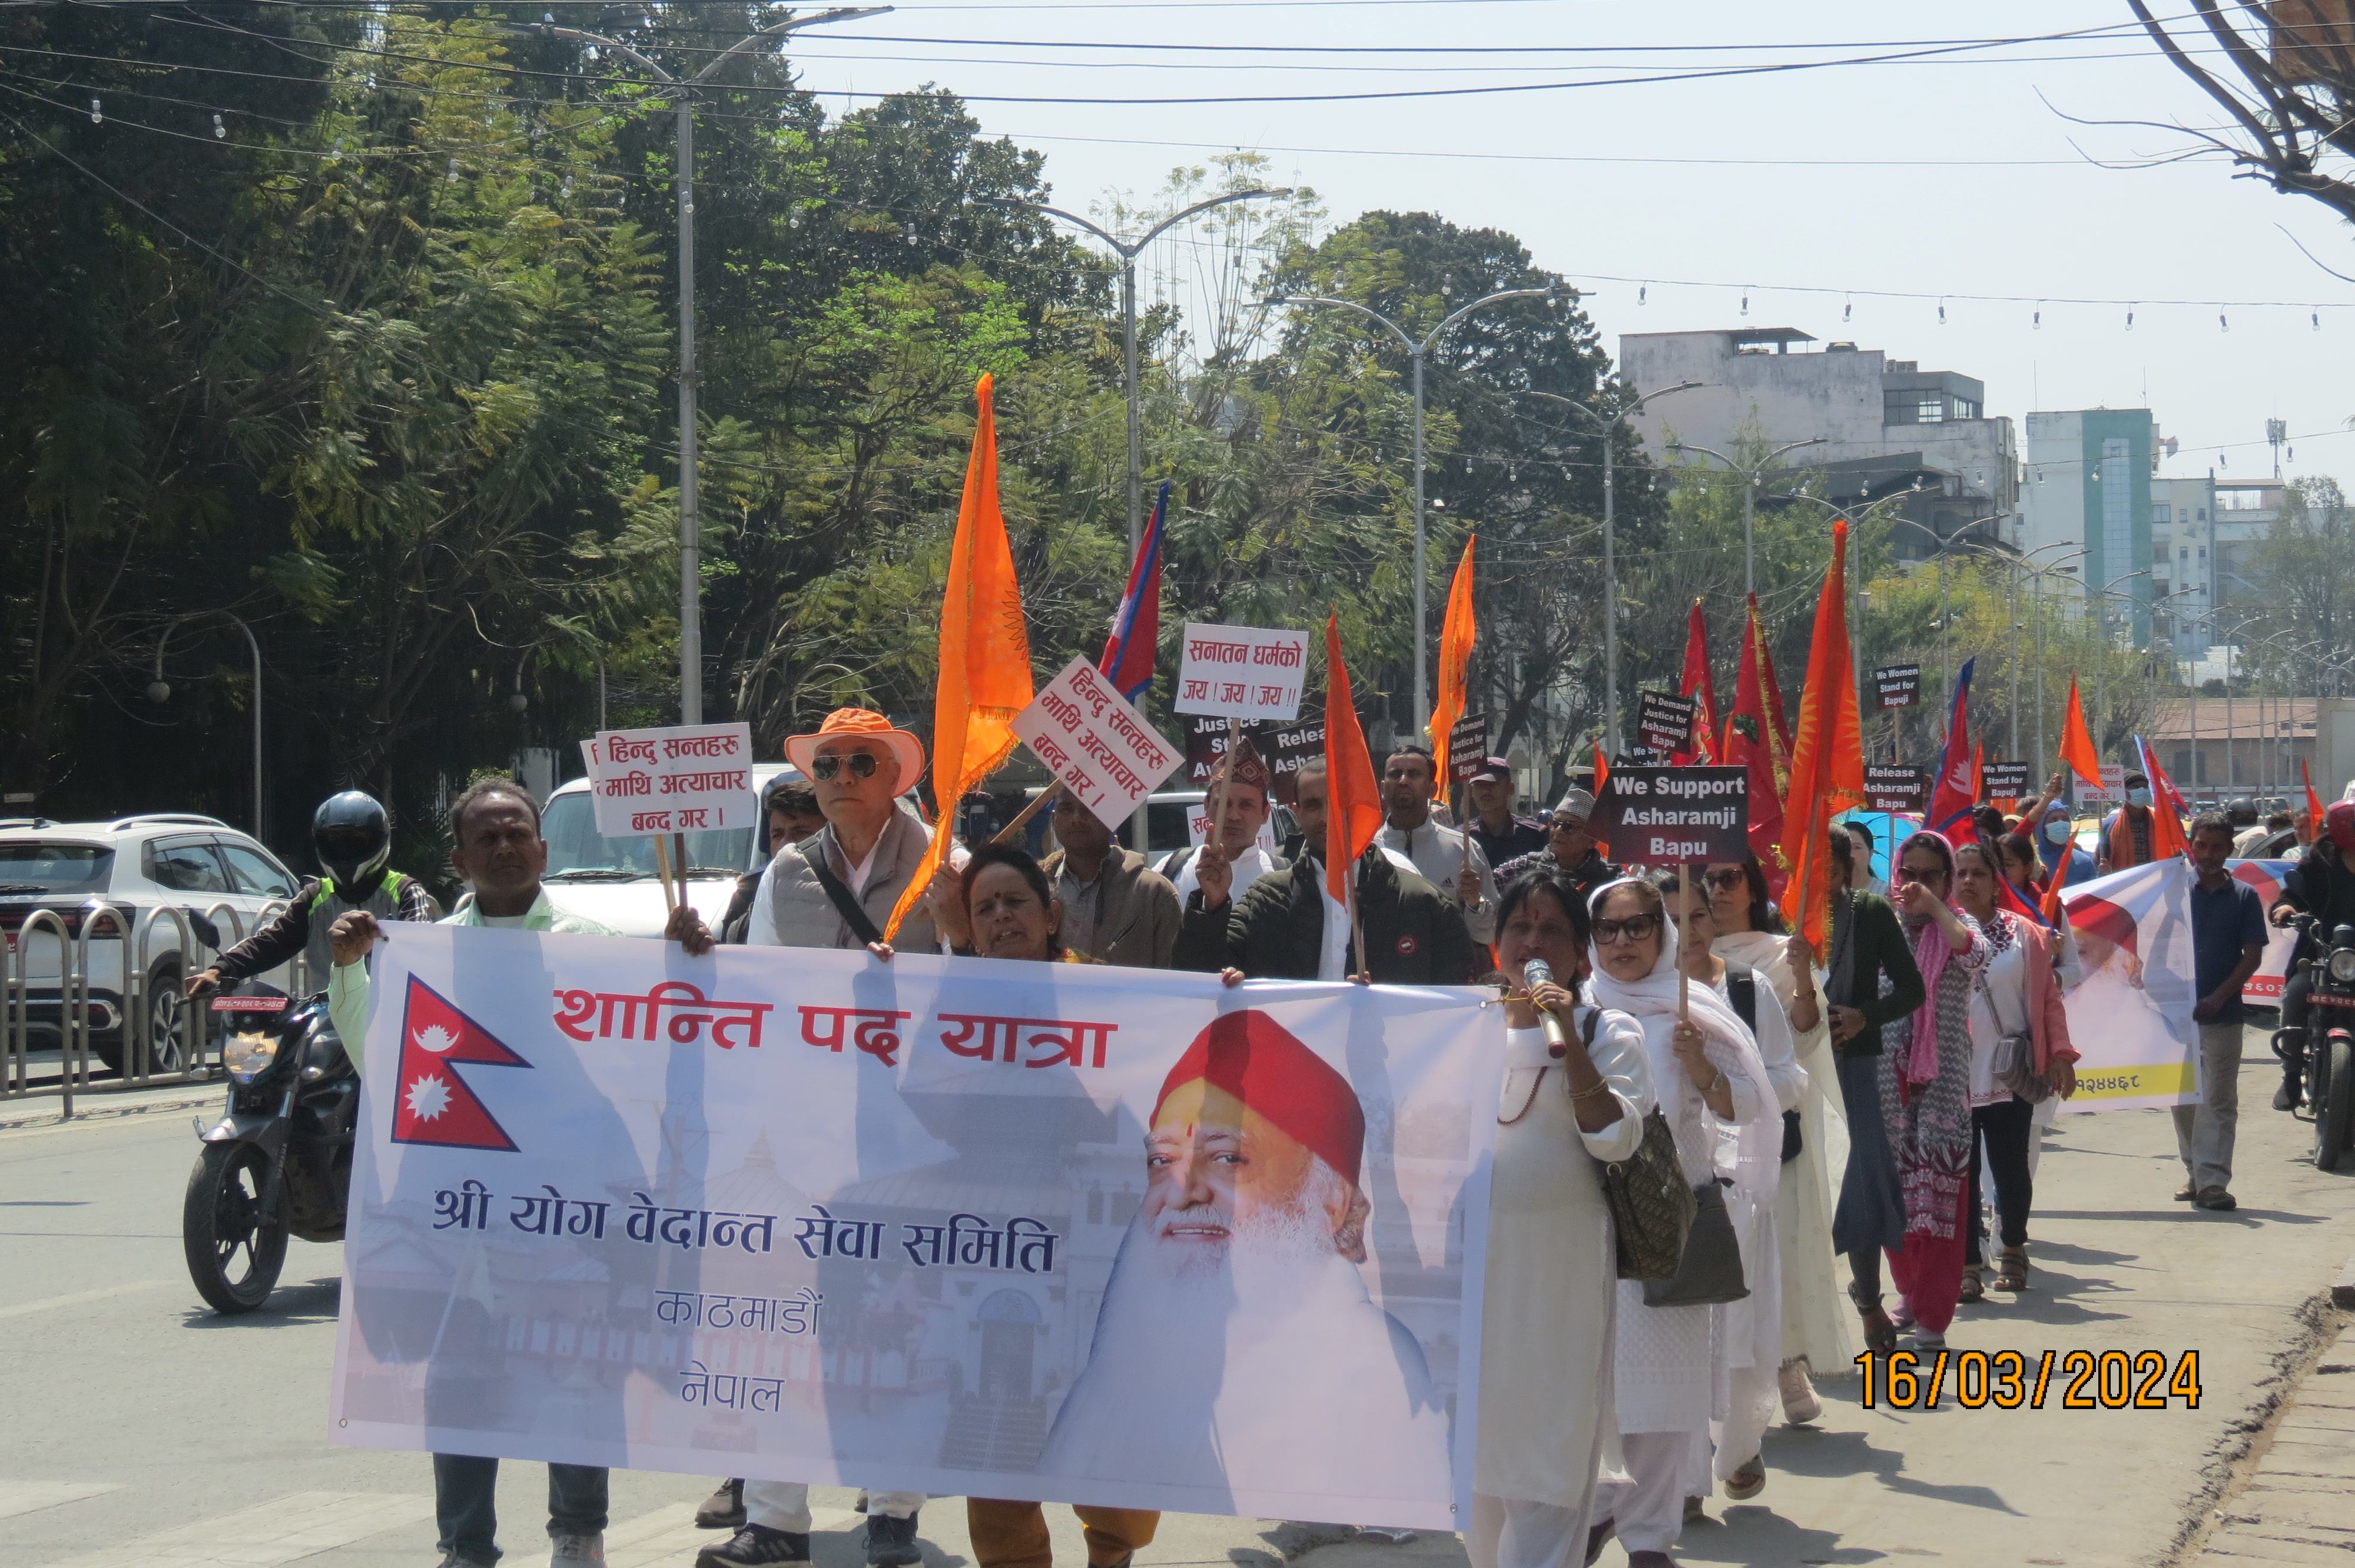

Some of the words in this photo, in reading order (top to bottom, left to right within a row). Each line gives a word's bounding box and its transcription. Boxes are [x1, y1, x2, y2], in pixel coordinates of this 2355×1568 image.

[1189, 640, 1250, 664] सनातन
[1253, 640, 1302, 668] धर्मको
[1876, 672, 1886, 680] We
[1888, 669, 1918, 678] Women
[1183, 680, 1209, 700] जय
[1220, 683, 1246, 704] जय
[1258, 686, 1283, 706] जय
[1880, 682, 1900, 693] Stand
[1902, 681, 1915, 689] for
[1645, 695, 1656, 704] We
[1658, 697, 1691, 712] Demand
[1885, 694, 1908, 706] Bapuji
[1644, 708, 1674, 721] Justice
[1676, 715, 1687, 724] for
[1194, 717, 1260, 733] Justce
[1461, 717, 1484, 733] Demand
[1641, 720, 1687, 739] Asharamji
[1041, 691, 1083, 733] माथि
[1078, 728, 1148, 800] अत्याचार
[1277, 729, 1325, 748] Relea
[1451, 738, 1474, 750] Justice
[1475, 734, 1483, 743] for
[1652, 734, 1675, 748] Bapu
[1450, 745, 1484, 765] Asharamji
[1633, 748, 1646, 756] We
[1033, 733, 1070, 771] बन्द
[1065, 765, 1095, 796] गर
[1458, 764, 1477, 776] Bapu
[1869, 768, 1915, 777] Release
[605, 770, 652, 796] माथि
[659, 770, 747, 795] अत्याचार
[1613, 777, 1647, 795] We
[1656, 776, 1744, 799] Support
[1863, 783, 1920, 795] Asharamji
[1986, 776, 2009, 785] Stand
[1992, 788, 2016, 797] Bapuji
[1876, 799, 1906, 810] Bapu
[632, 811, 671, 831] बन्द
[678, 809, 708, 828] गर
[1621, 807, 1736, 829] Asharamji
[1650, 838, 1707, 859] Bapu
[552, 981, 774, 1049] शान्ति
[798, 1005, 911, 1069] पद
[937, 1014, 1119, 1069] यात्रा
[432, 1179, 492, 1231] श्री
[510, 1185, 610, 1241] योग
[625, 1192, 777, 1254] वेदान्त
[794, 1204, 886, 1260] सेवा
[901, 1213, 1060, 1274] समिति
[679, 1360, 785, 1412] नेपाल
